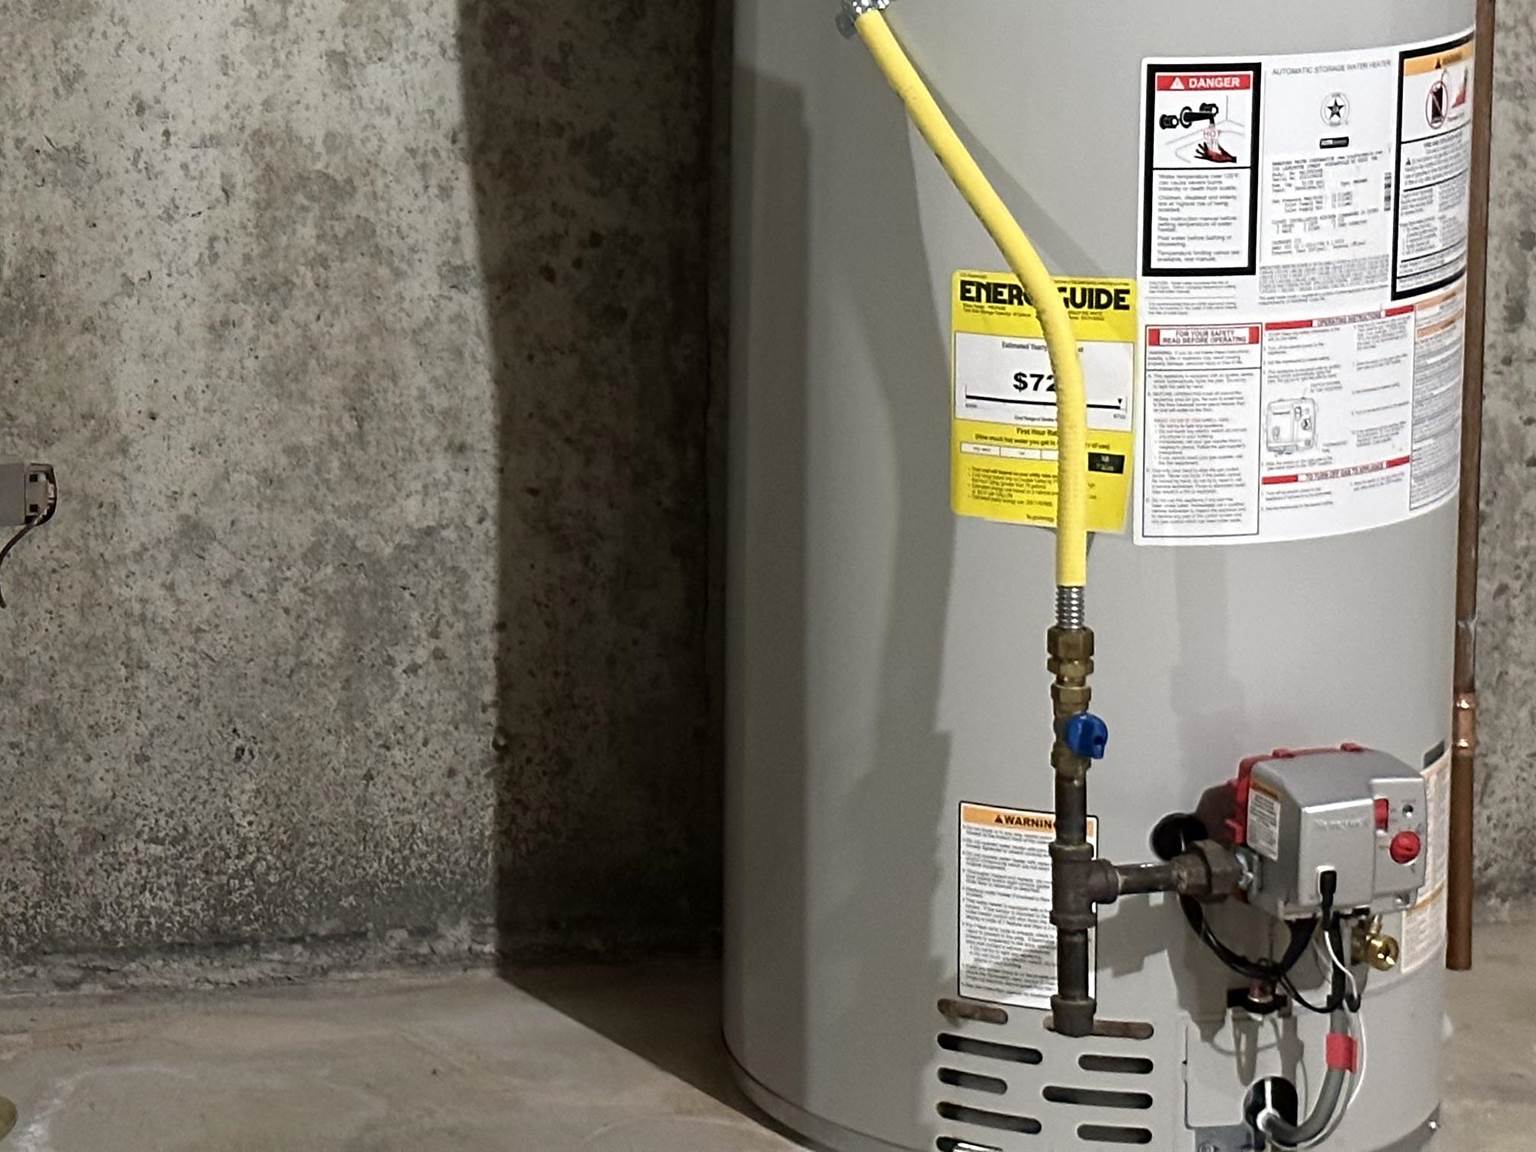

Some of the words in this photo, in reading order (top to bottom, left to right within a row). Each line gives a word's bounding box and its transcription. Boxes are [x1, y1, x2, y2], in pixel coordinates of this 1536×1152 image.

[1272, 67, 1313, 75] AUTOMATIC
[1315, 65, 1344, 73] STORAGE
[1369, 60, 1391, 68] HEATER
[1189, 77, 1240, 88] DANGER
[1016, 428, 1031, 436] First
[1004, 815, 1056, 828] WARNIN
